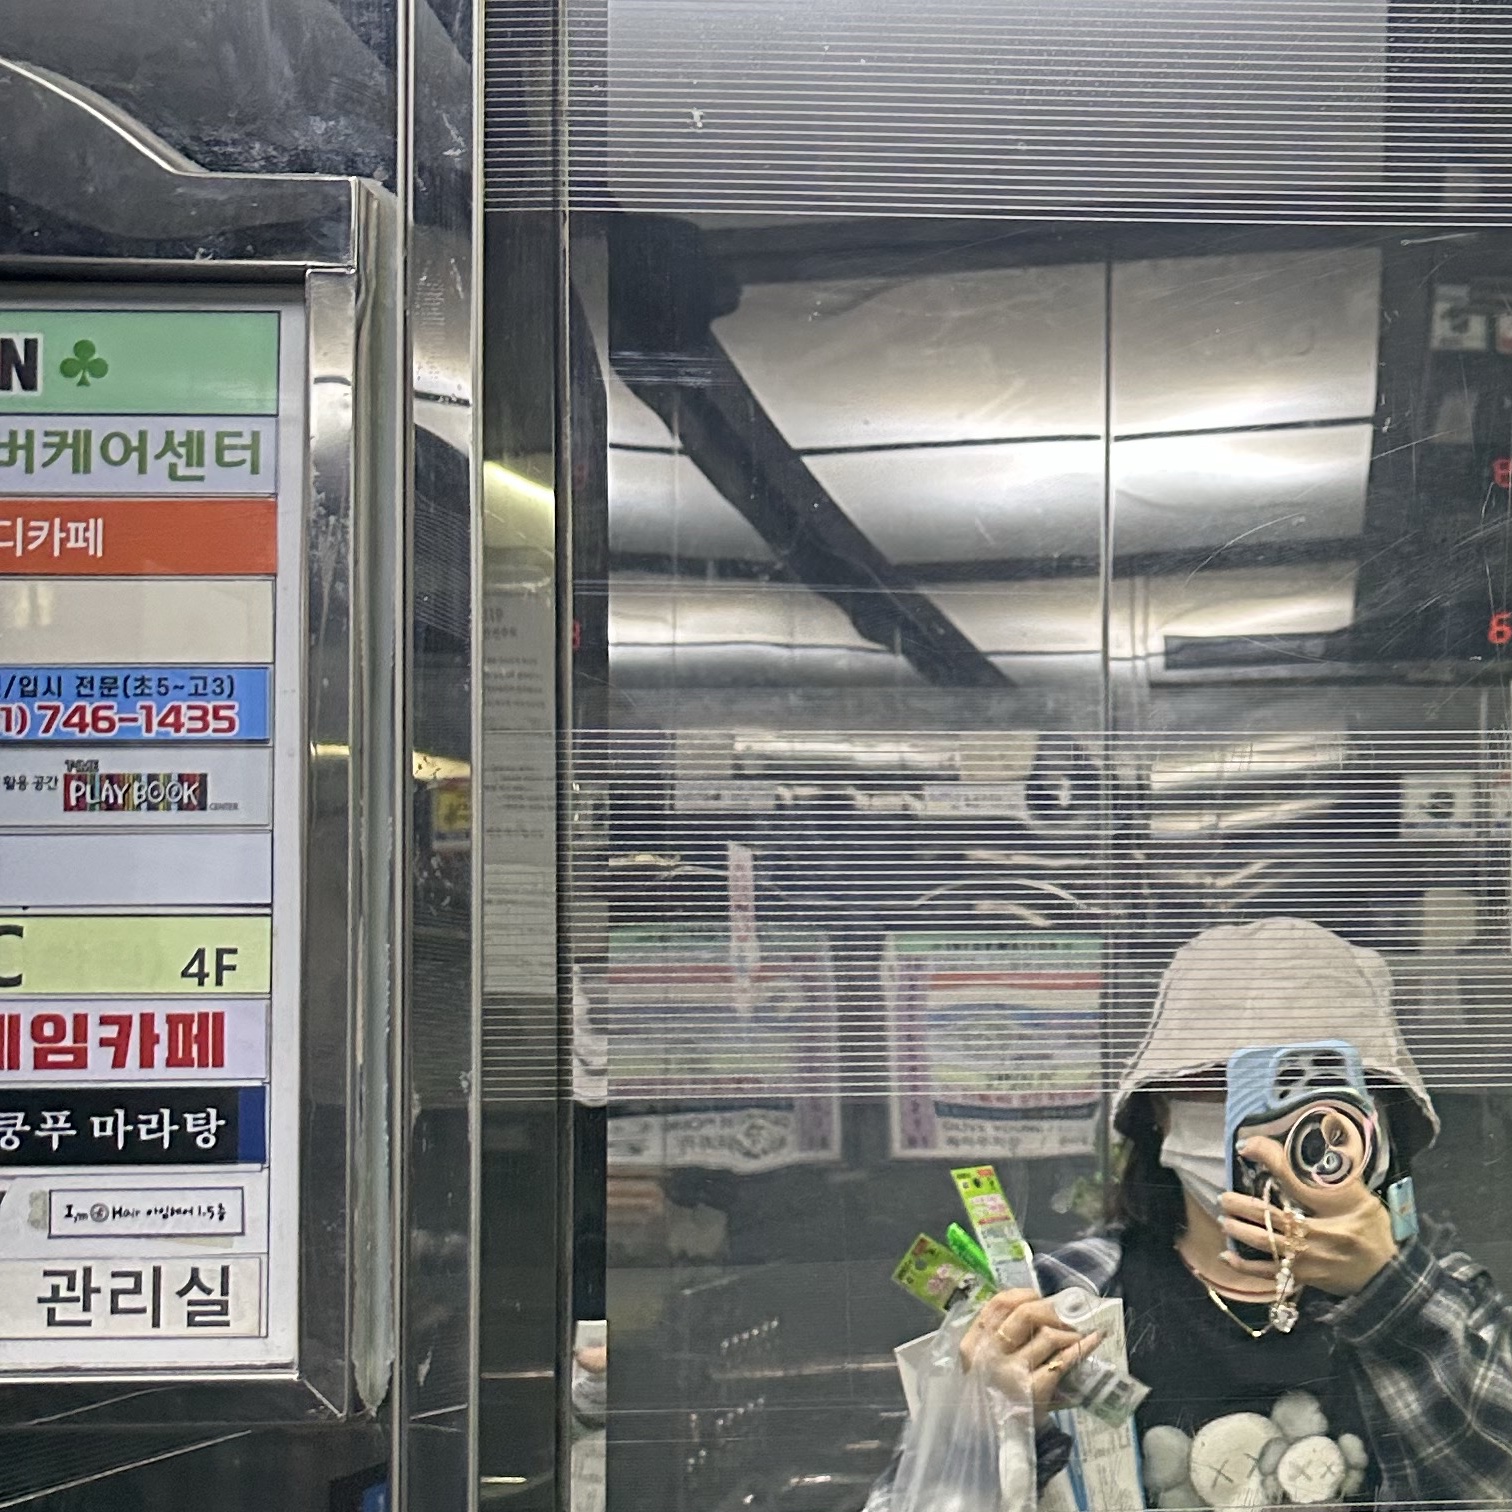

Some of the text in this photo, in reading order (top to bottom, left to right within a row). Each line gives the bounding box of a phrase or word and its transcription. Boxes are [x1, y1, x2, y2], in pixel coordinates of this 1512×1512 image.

[0, 337, 39, 392] N
[0, 428, 262, 482] 버케어센터
[0, 516, 104, 558] 디카페
[3, 674, 235, 699] /입시 전문(초5~고3)
[36, 703, 238, 735] 746-1435
[32, 775, 59, 791] 공간
[180, 947, 239, 987] 4F
[0, 1108, 227, 1152] 쿵푸 마라탕
[37, 1264, 231, 1329] 관리실
